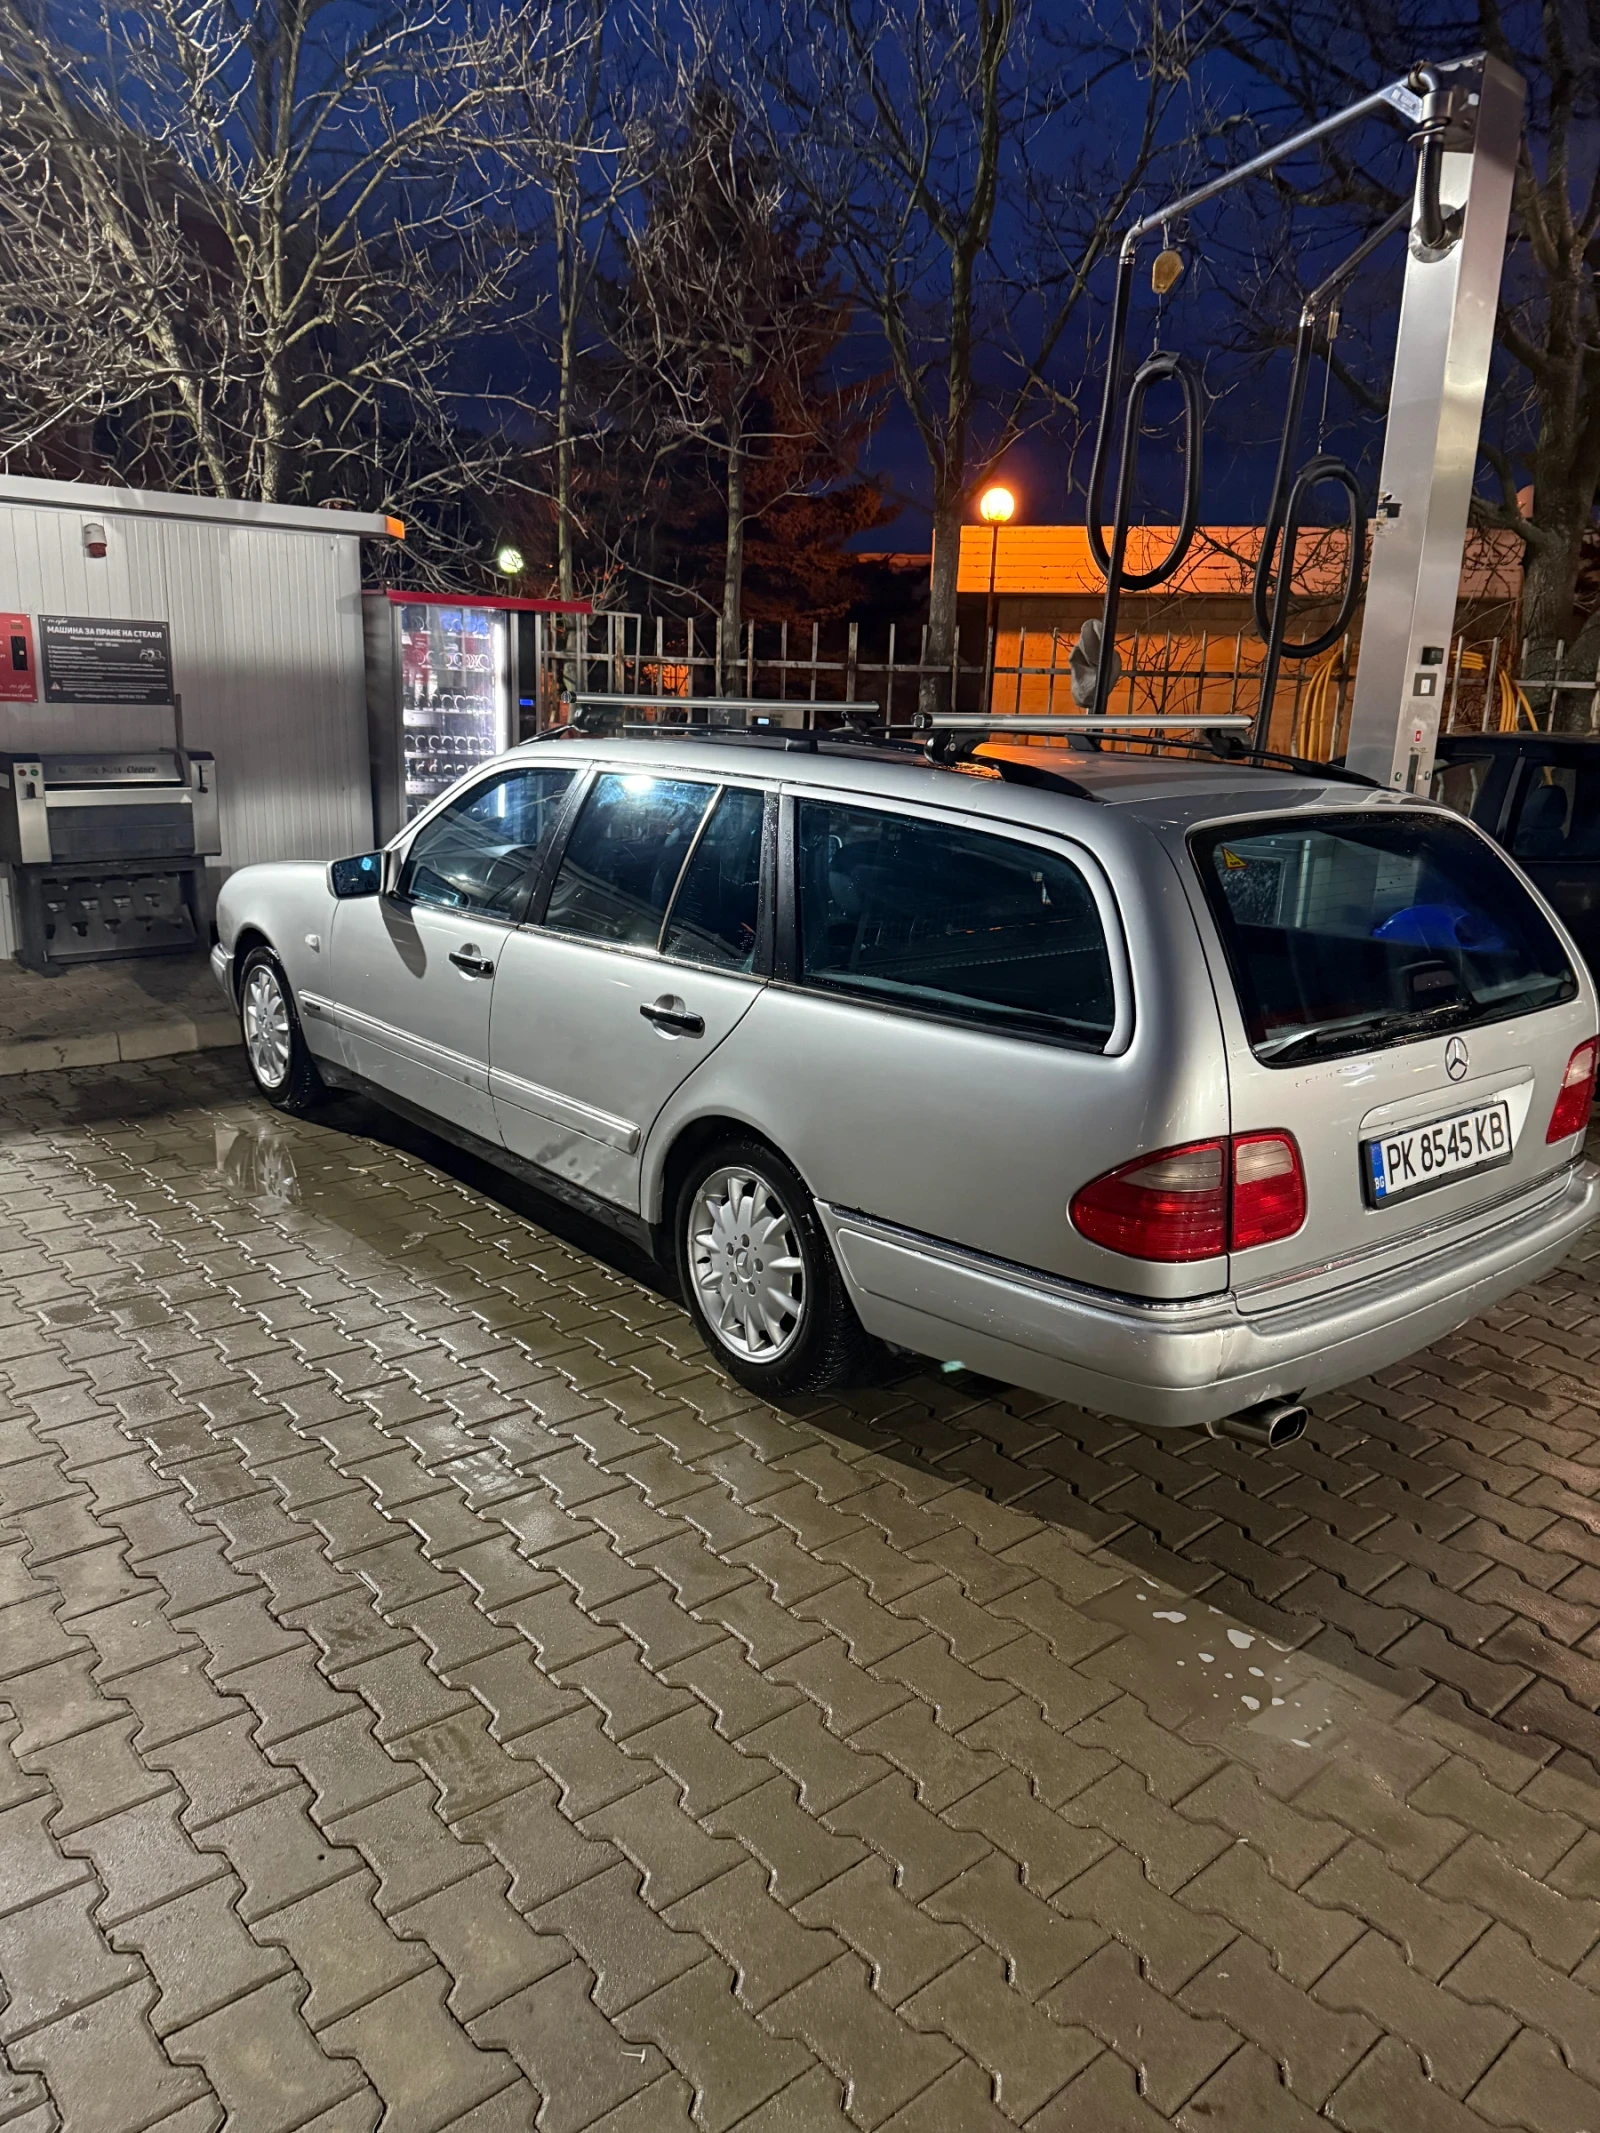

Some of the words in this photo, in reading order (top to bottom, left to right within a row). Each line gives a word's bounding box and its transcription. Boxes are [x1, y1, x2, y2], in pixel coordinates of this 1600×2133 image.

[47, 625, 84, 634] МАШИНА
[84, 627, 95, 636] ЗА
[96, 628, 121, 636] ПРАНЕ
[122, 629, 133, 637] НА
[134, 630, 162, 639] СТЕЛКИ
[126, 765, 156, 774] Cleaner
[1386, 1137, 1417, 1185] PK
[1421, 1120, 1473, 1172] 8545
[1475, 1112, 1504, 1155] KB
[1374, 1175, 1385, 1190] BG
